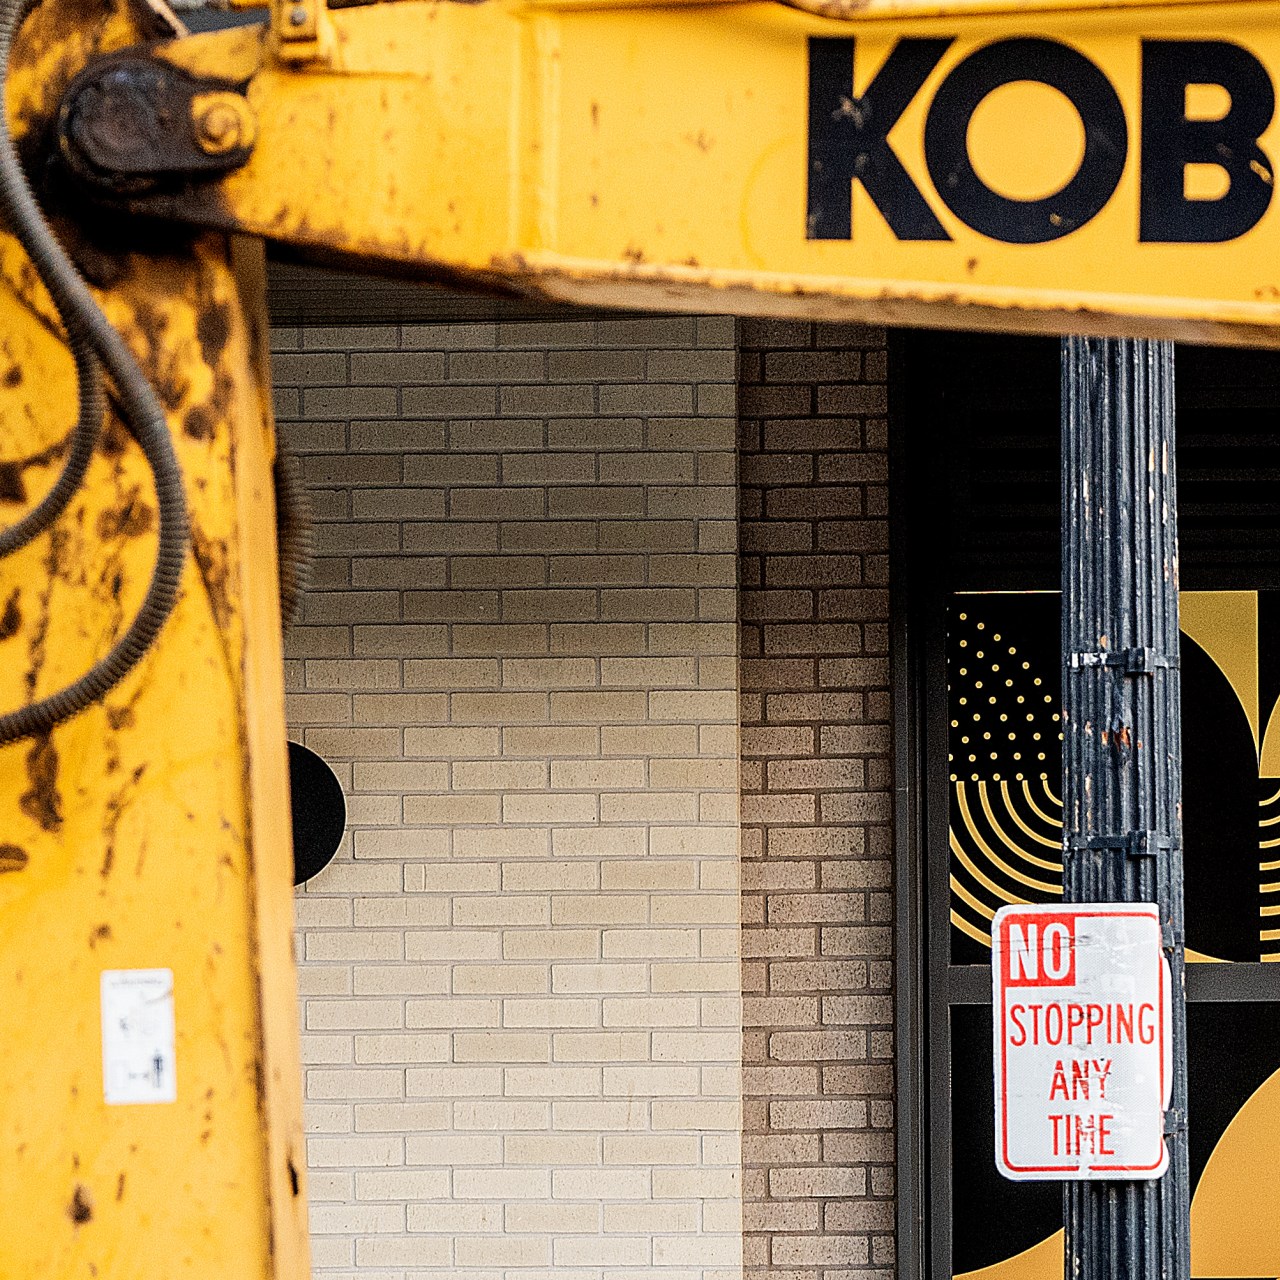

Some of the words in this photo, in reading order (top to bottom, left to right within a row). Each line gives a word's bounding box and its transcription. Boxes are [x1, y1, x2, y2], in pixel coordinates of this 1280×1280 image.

[1008, 922, 1072, 981] NO
[1009, 1002, 1156, 1047] STOPPING
[1049, 1059, 1112, 1101] ANY
[1047, 1114, 1115, 1156] TIME
